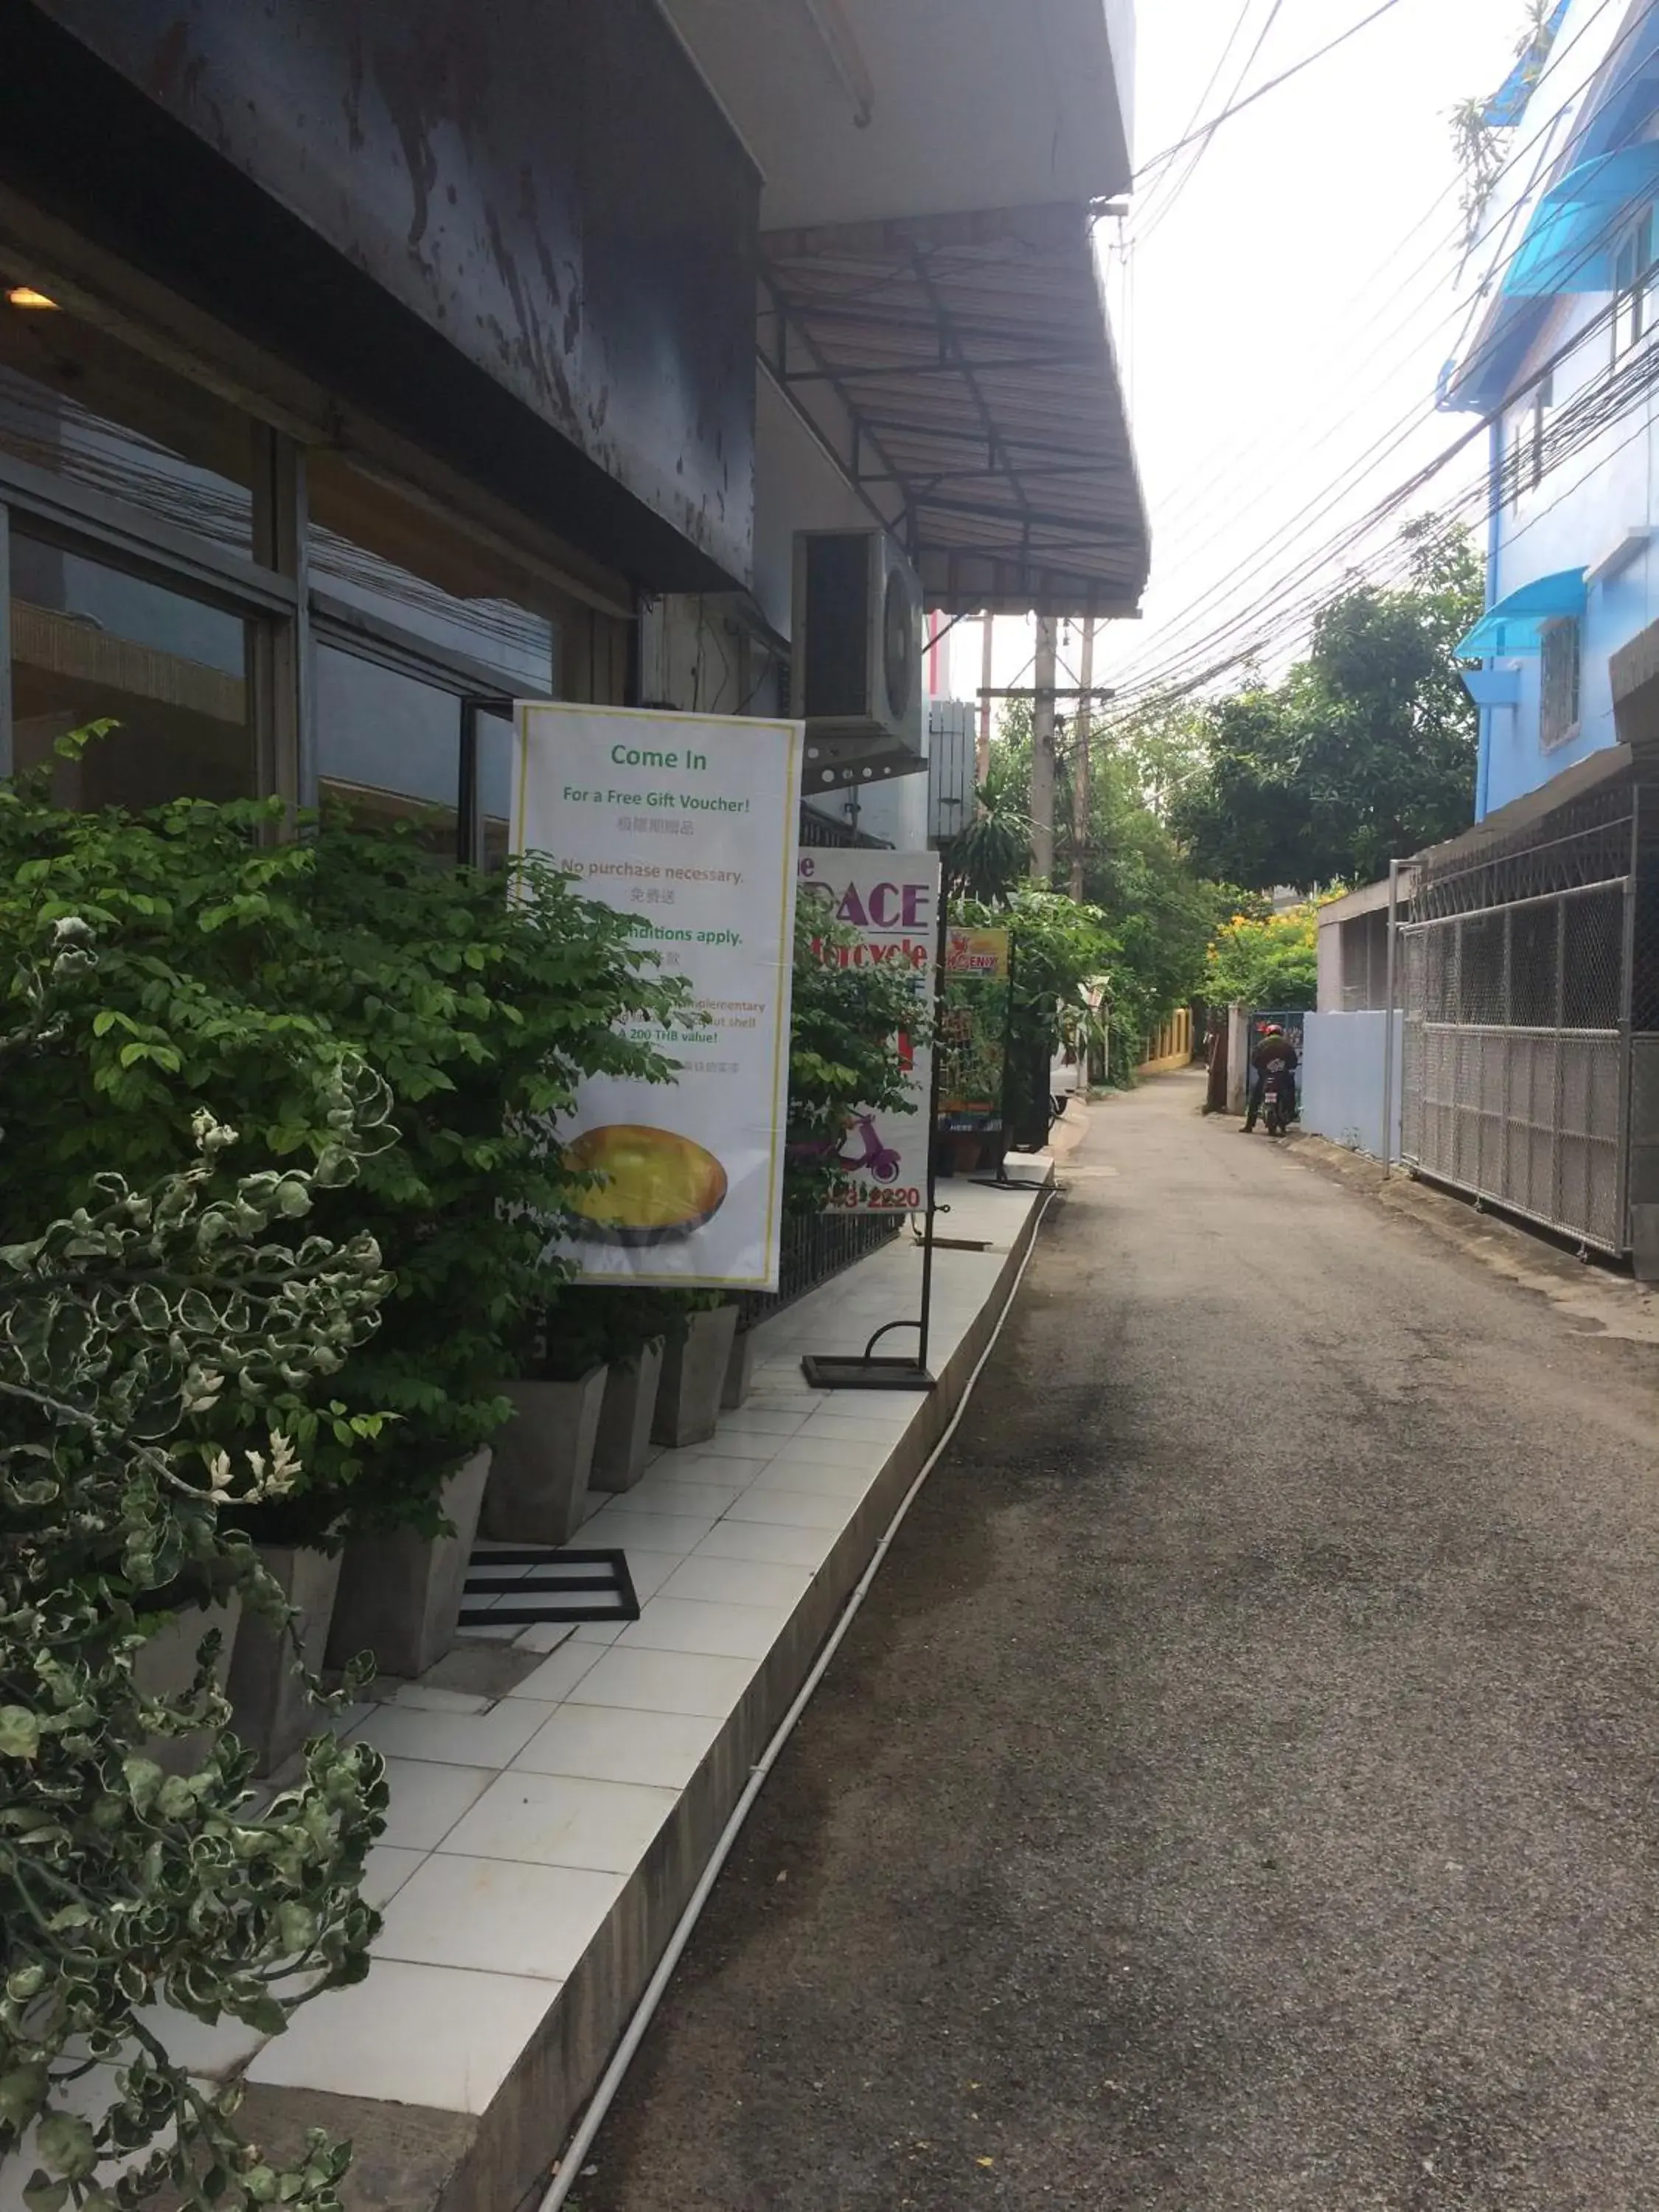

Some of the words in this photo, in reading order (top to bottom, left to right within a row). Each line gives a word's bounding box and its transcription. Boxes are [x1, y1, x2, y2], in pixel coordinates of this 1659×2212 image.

[611, 744, 678, 768] Come
[686, 750, 706, 771] In
[563, 786, 588, 801] For
[594, 791, 602, 803] a
[608, 789, 641, 805] Free
[647, 791, 675, 808] Gift
[680, 794, 750, 813] Voucher!
[561, 858, 585, 874] No
[589, 860, 661, 879] purchase
[665, 867, 744, 886] necessary.
[624, 925, 692, 942] nditions
[696, 928, 743, 947] apply.
[630, 1028, 650, 1040] 200
[655, 1029, 678, 1041] THB
[681, 1031, 717, 1043] value!
